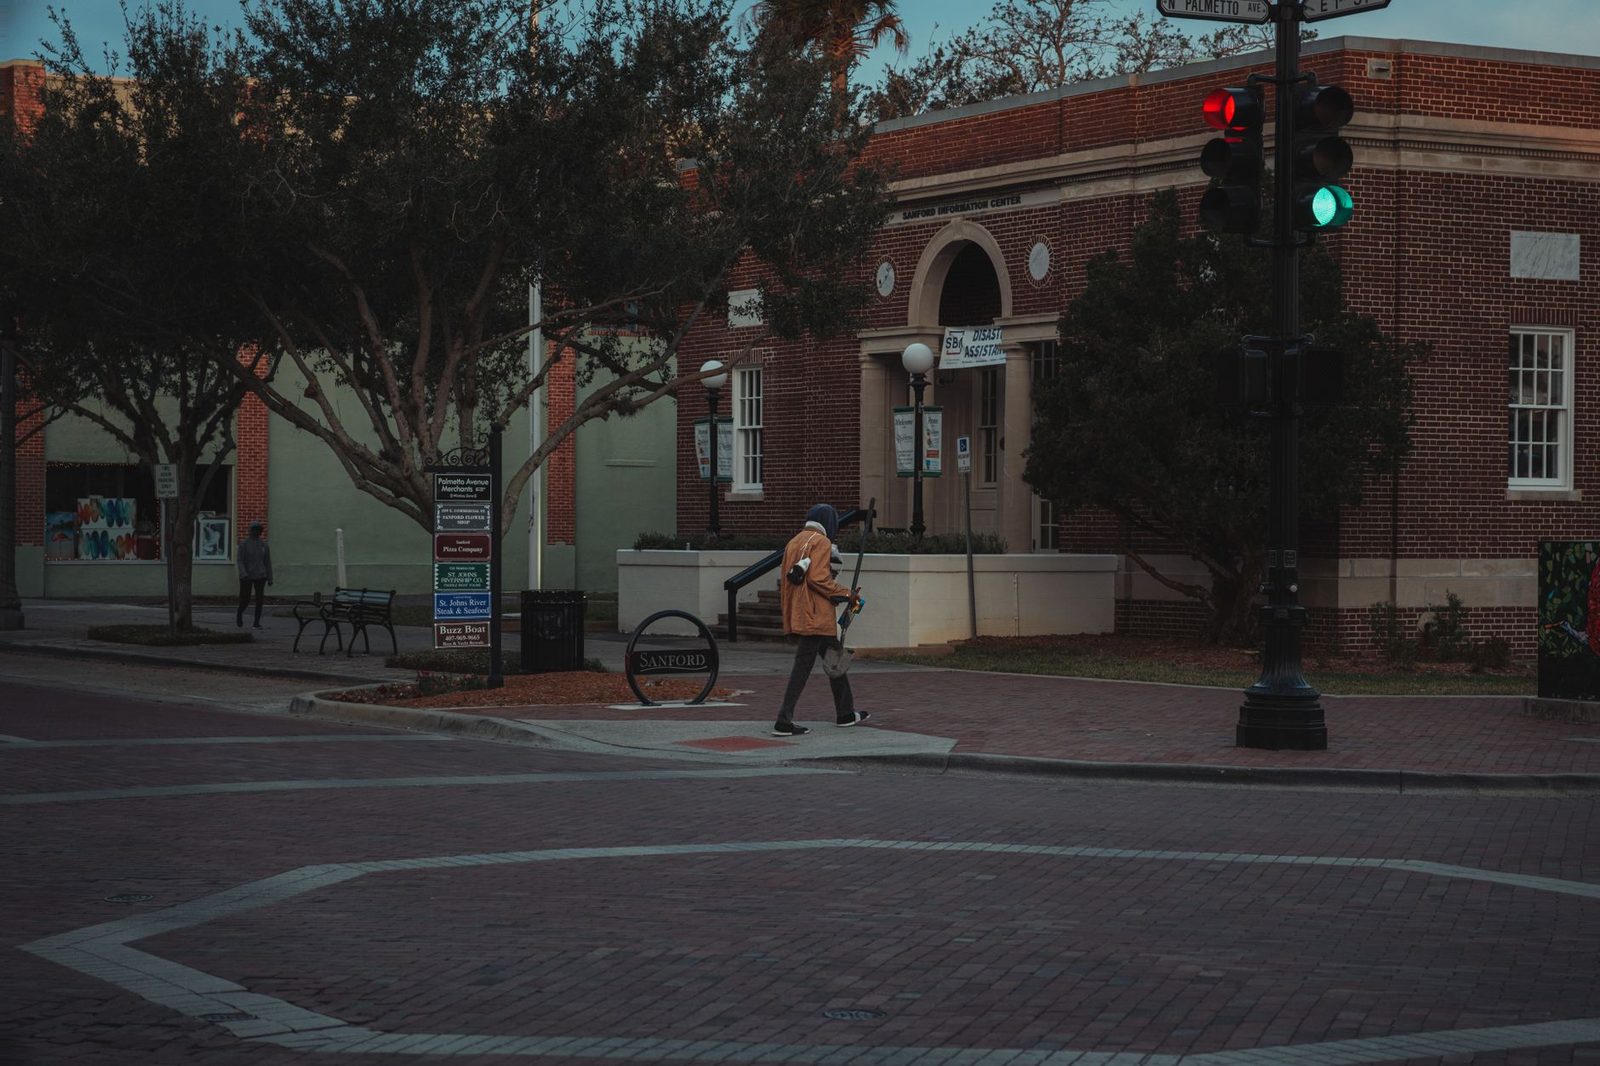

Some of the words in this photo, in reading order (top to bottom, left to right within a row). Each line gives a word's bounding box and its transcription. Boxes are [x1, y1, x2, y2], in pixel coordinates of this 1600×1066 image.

[1168, 0, 1175, 9] N
[1185, 0, 1239, 15] PALMETTO
[1321, 0, 1328, 12] E
[902, 208, 936, 220] SANFORD
[937, 201, 989, 215] INFORMATION
[990, 196, 1022, 208] CENTER
[437, 477, 465, 485] Palmetto
[465, 478, 489, 486] Avenue
[458, 546, 483, 554] Company
[449, 599, 468, 607] Johns
[469, 598, 487, 606] River
[436, 607, 454, 615] Steak
[463, 606, 490, 614] Seafood
[440, 625, 463, 635] Buzz
[465, 625, 486, 634] Boat
[639, 652, 706, 668] SANFORD
